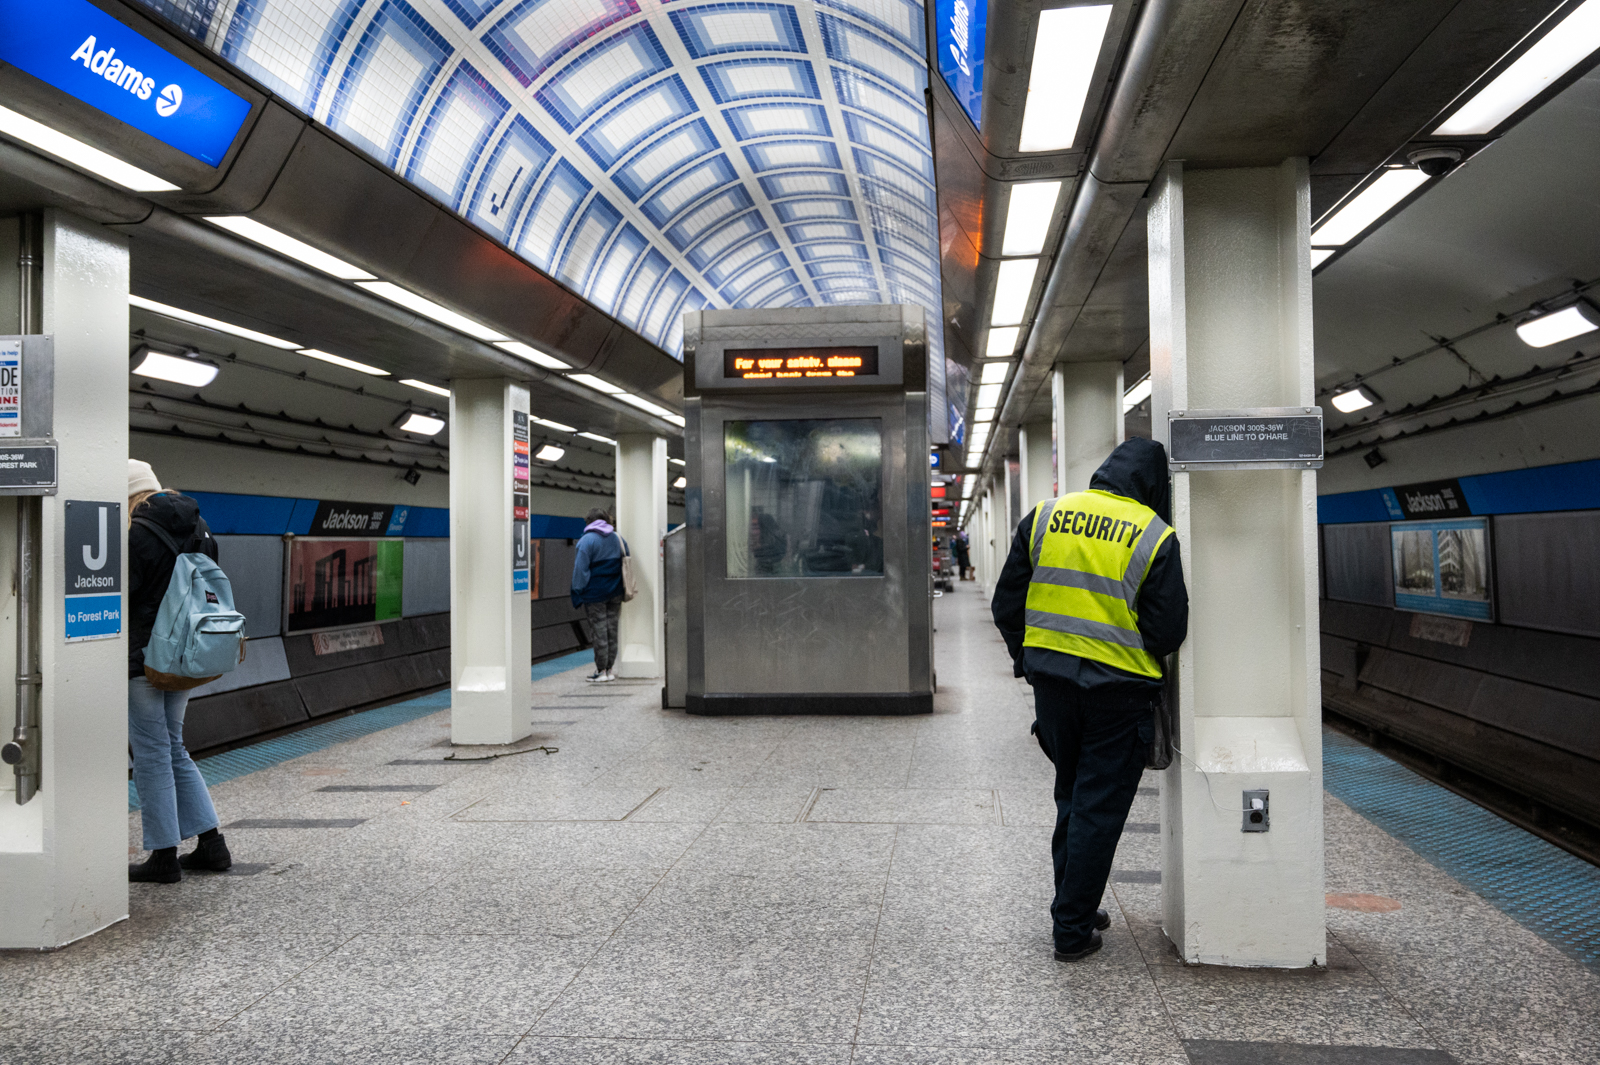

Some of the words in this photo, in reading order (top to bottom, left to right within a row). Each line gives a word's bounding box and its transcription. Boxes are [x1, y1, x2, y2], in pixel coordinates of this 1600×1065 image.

[71, 35, 155, 100] Adams
[735, 357, 754, 369] For
[1204, 433, 1225, 441] BLUE
[1226, 433, 1244, 441] LINE
[1245, 433, 1257, 441] TO
[1258, 432, 1289, 441] O'HARE
[1208, 423, 1246, 433] JACKSON
[1247, 423, 1284, 432] 300S-36W
[20, 461, 38, 469] PARK
[1405, 491, 1446, 513] Jackson
[322, 508, 369, 530] Jackson
[1049, 509, 1143, 549] SECURITY
[82, 506, 108, 571] J
[517, 524, 525, 558] J
[74, 574, 114, 589] Jackson
[68, 613, 76, 623] to
[77, 611, 102, 623] Forest
[103, 609, 120, 621] Park
